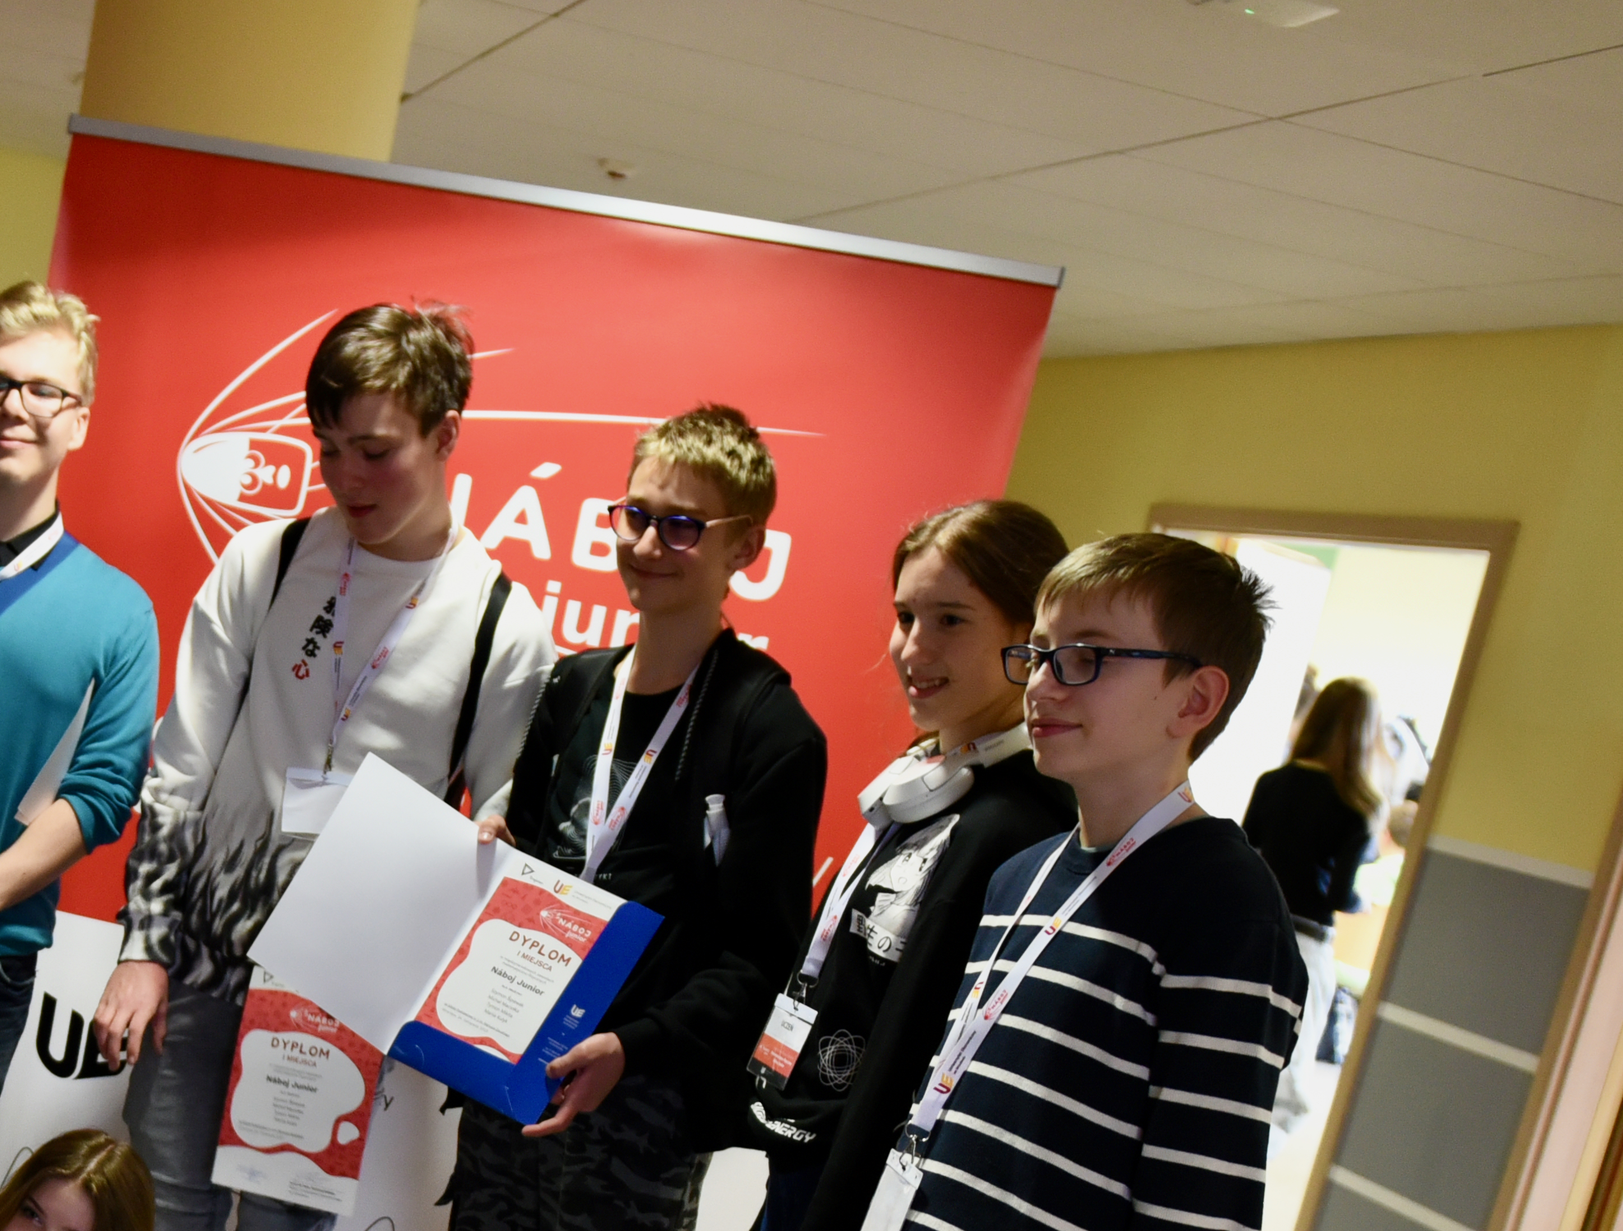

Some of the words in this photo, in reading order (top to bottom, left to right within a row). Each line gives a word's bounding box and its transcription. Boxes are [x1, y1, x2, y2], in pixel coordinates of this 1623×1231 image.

[553, 879, 574, 896] UE
[558, 918, 593, 938] NÁBOJ
[1044, 917, 1062, 936] UE
[509, 931, 573, 967] DYPLOM
[521, 952, 553, 973] MIEJSCA
[490, 966, 517, 984] Náboj
[516, 979, 545, 996] Junior
[271, 1037, 331, 1060] DYPLOM
[933, 1073, 954, 1095] UE
